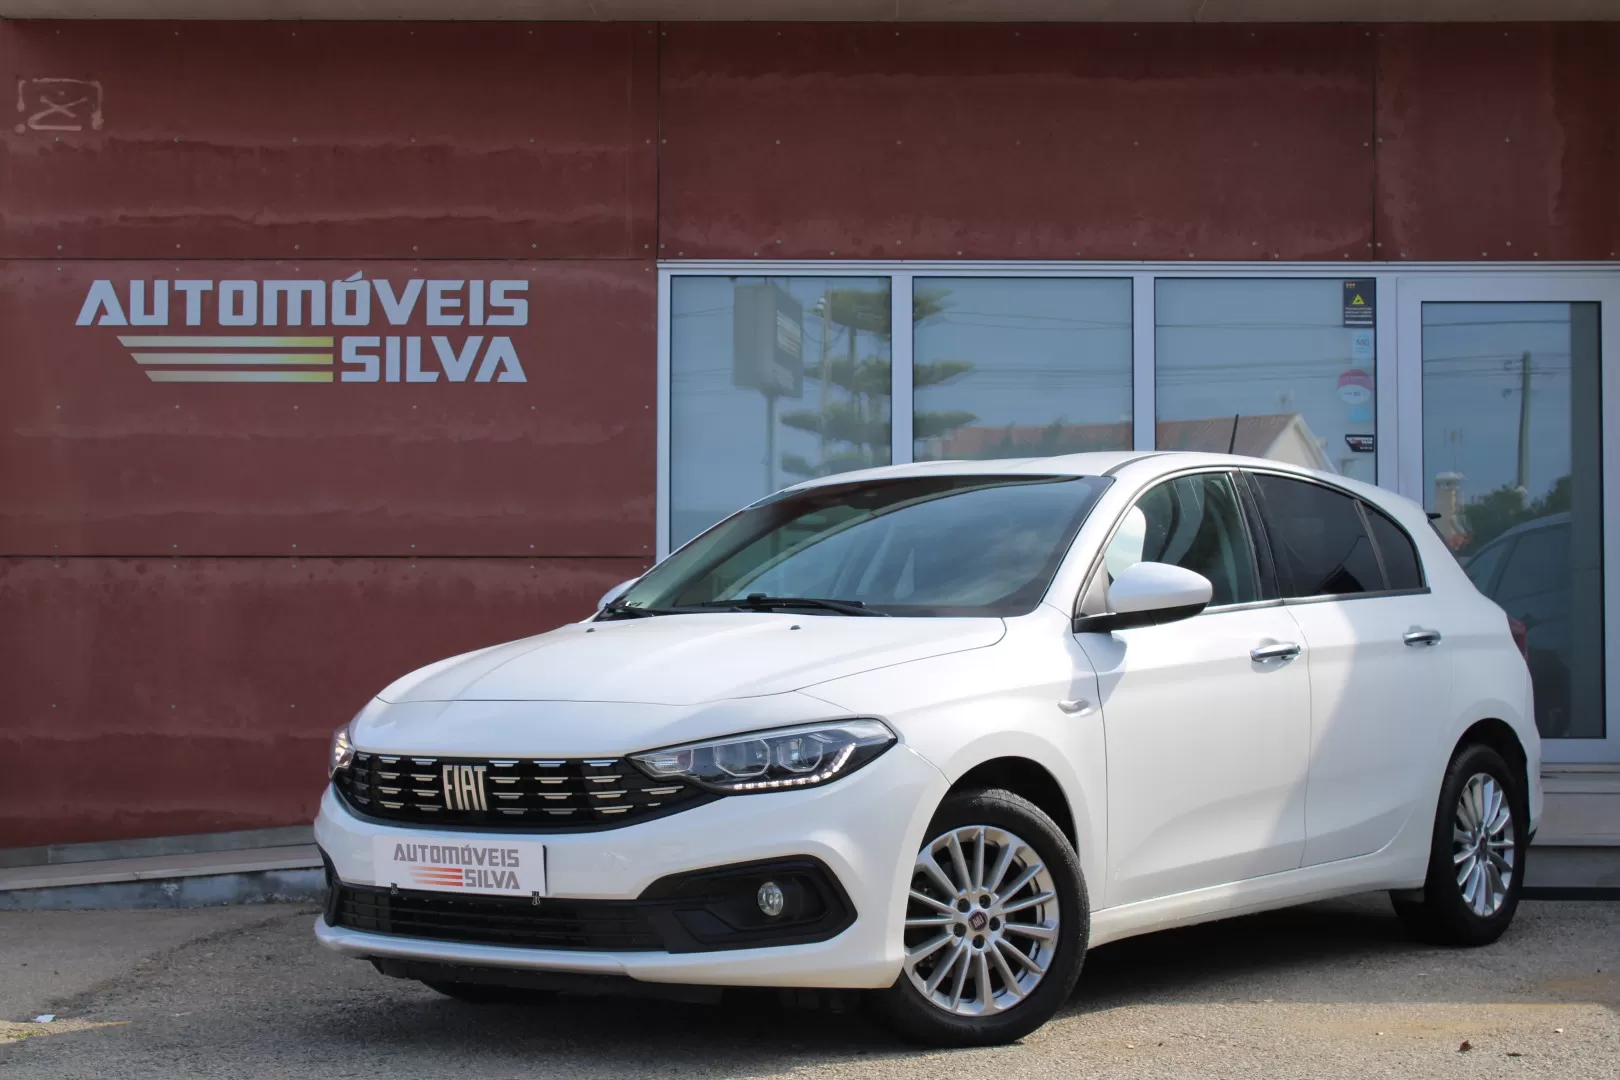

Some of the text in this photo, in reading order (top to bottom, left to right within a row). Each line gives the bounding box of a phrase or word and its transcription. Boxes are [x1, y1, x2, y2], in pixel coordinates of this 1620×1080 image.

[75, 270, 529, 326] AUTOMÓVEIS
[341, 336, 528, 382] SILVA
[443, 765, 487, 811] FIAT
[393, 843, 520, 867] AUTOMÓVEIS
[464, 869, 520, 889] SILVA
